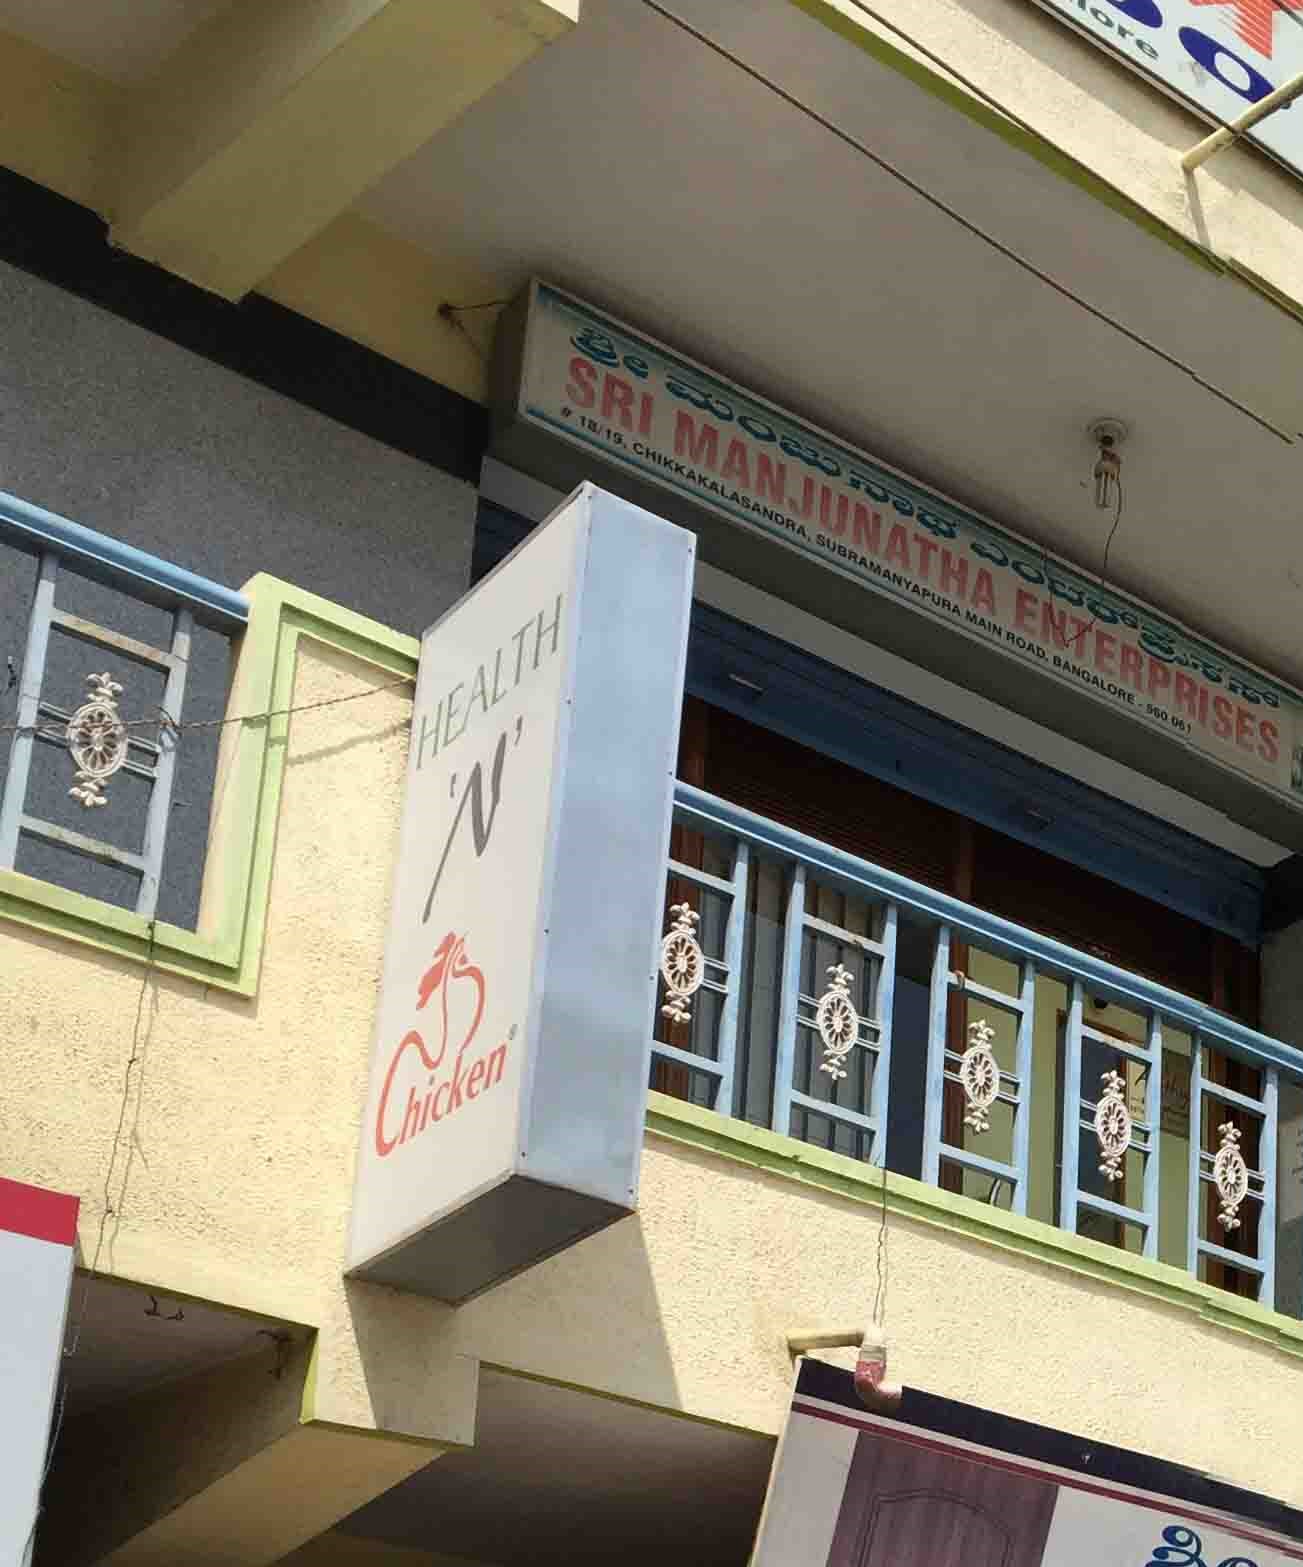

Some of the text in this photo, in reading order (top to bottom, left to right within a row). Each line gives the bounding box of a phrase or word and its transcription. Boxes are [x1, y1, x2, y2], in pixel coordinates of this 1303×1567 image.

[566, 356, 1281, 764] SRI MANJUNATHA ENTERPRISES
[633, 441, 811, 542] CHIKKAKALASANDRA,
[815, 531, 962, 617] SUBRAMANYAPURA
[965, 606, 1002, 638] MAIN
[1052, 655, 1136, 705] BANGALORE
[415, 593, 563, 770] HEALTH
[375, 1028, 507, 1158] Chicken
